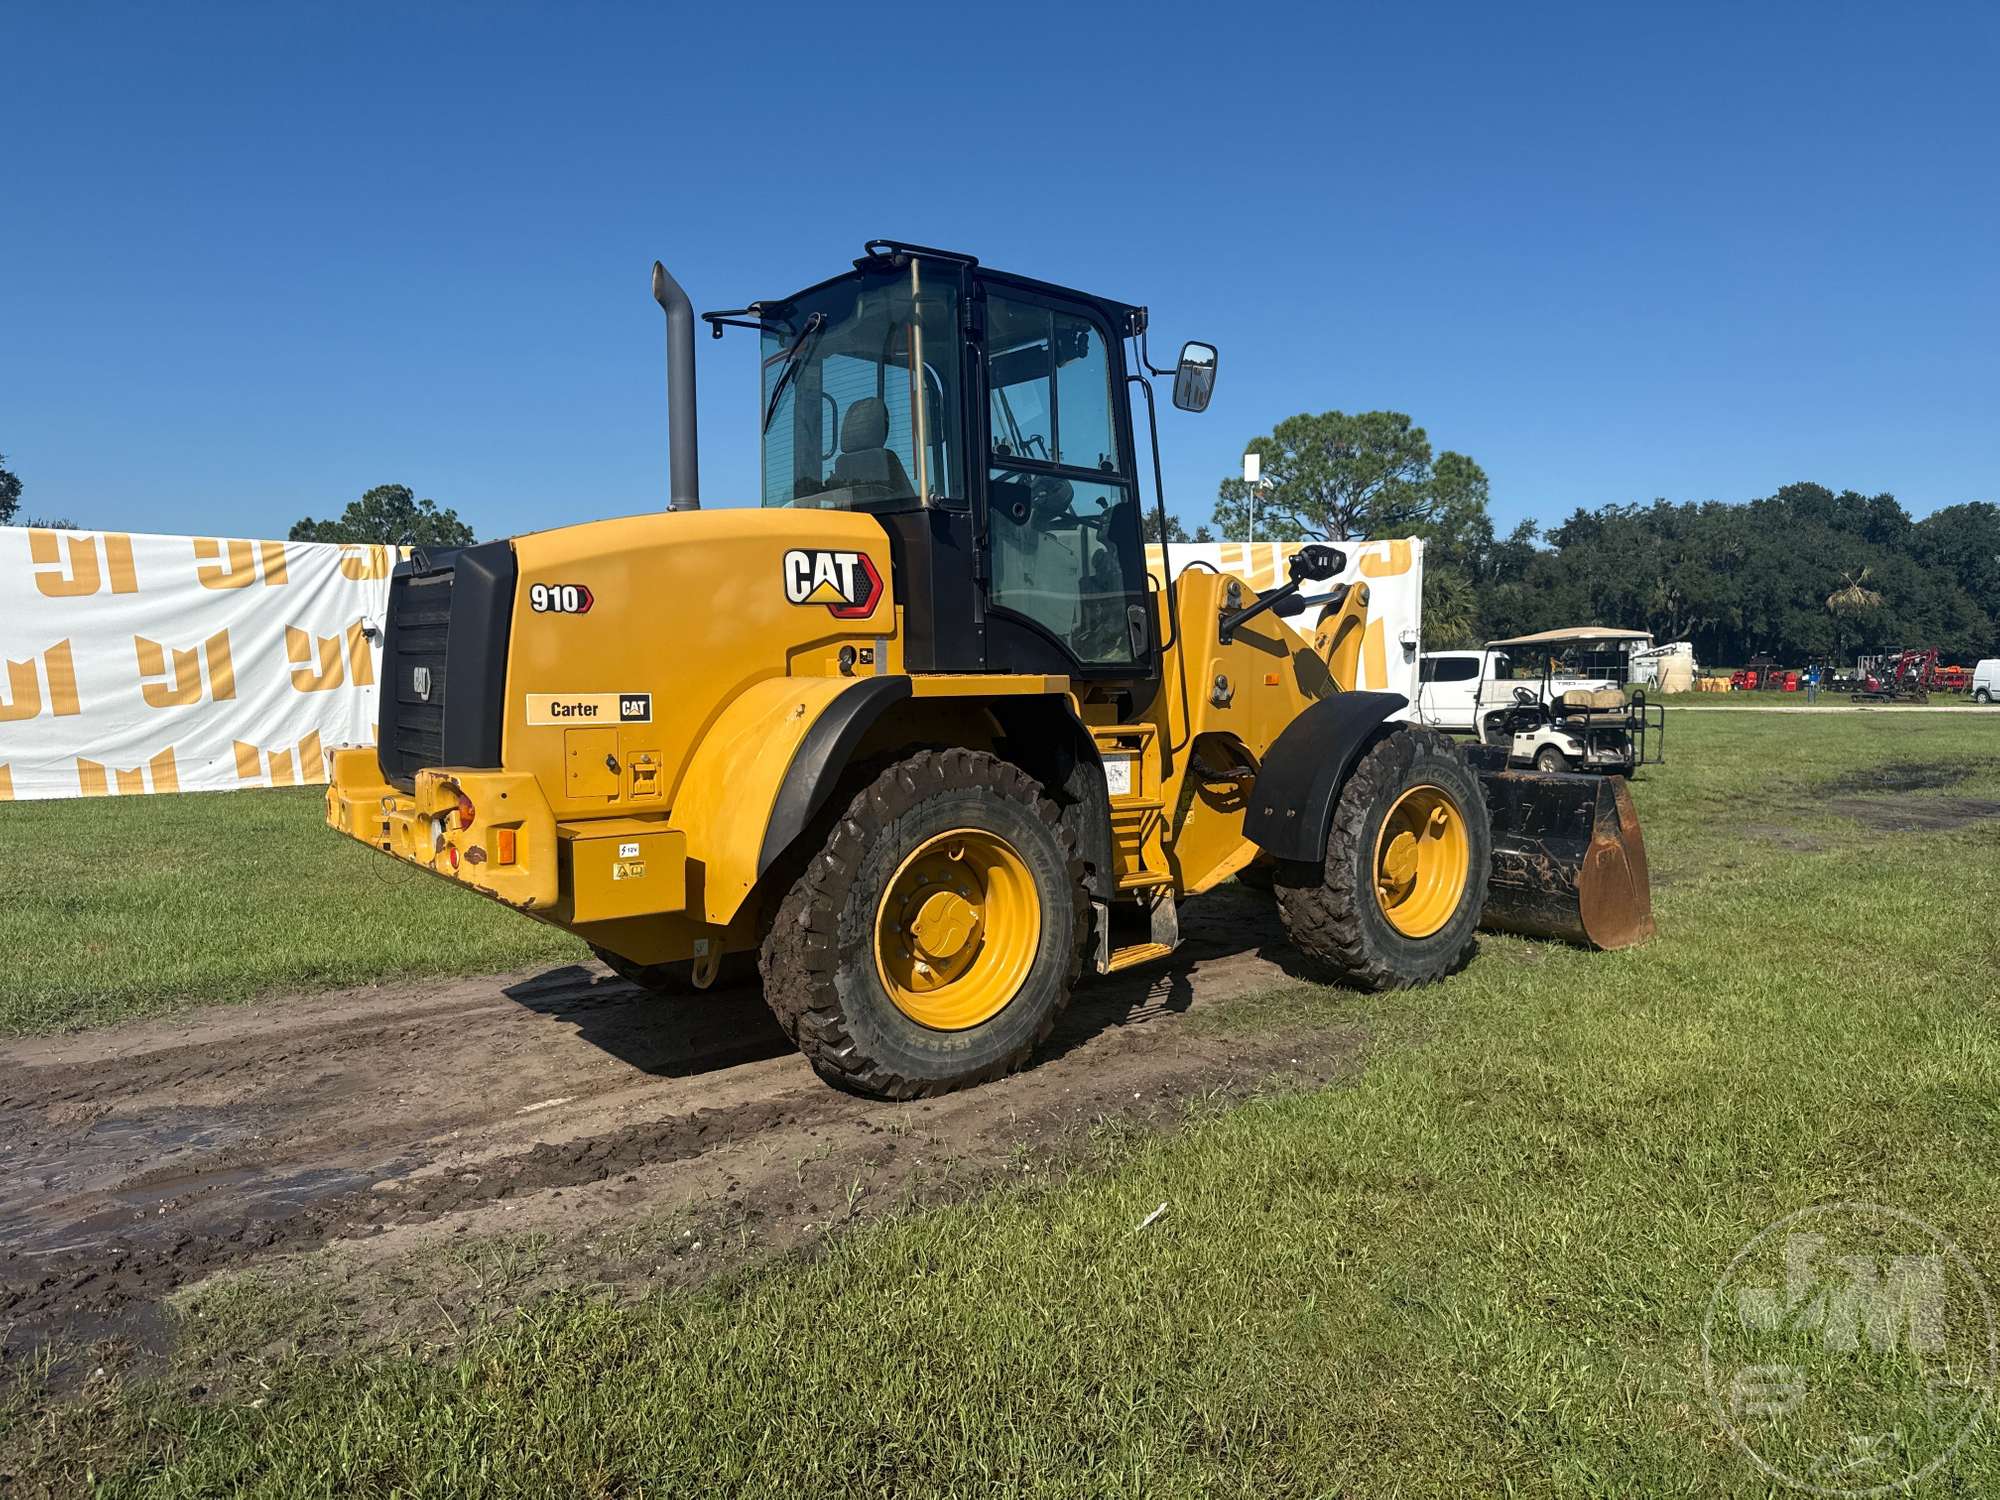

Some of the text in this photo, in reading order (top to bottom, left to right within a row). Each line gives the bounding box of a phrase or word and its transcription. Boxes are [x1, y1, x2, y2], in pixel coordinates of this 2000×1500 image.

[785, 551, 858, 603] CAT
[532, 585, 579, 612] 910
[551, 701, 646, 717] Carter CAT
